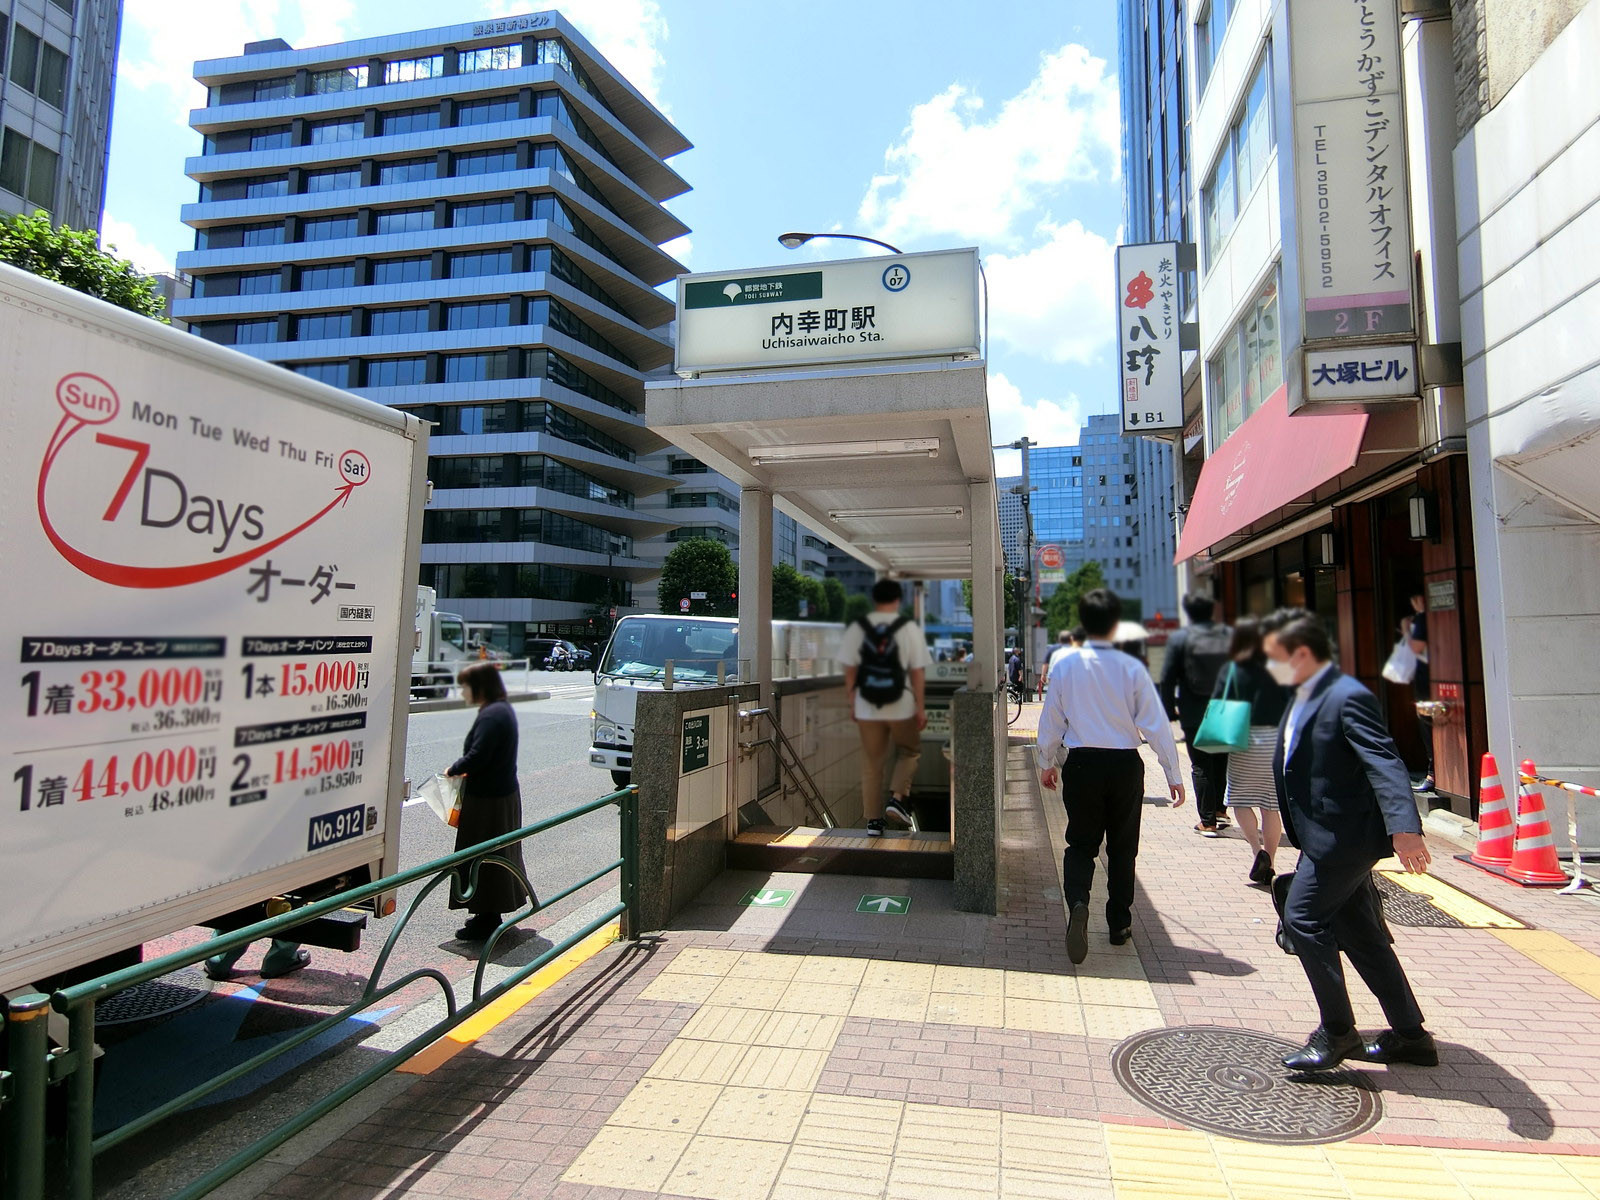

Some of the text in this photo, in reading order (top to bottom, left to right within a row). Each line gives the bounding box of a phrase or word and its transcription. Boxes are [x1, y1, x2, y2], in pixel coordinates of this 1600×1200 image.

[1354, 0, 1395, 281] とうかずこデンタルオフィス
[744, 282, 783, 293] 都営地下鉄
[889, 276, 903, 287] 07
[759, 291, 783, 299] SUBWAY
[1158, 257, 1174, 340] 炭火やきとり
[771, 305, 876, 337] 内幸町駅
[762, 330, 885, 350] Uchisaiwaicho Sta.
[1312, 360, 1408, 386] 大塚ビル
[66, 384, 366, 477] Sun Mon Tue Wed Thu Fri Sat
[1145, 412, 1164, 423] B1
[246, 560, 356, 604] オーダー
[340, 607, 373, 619] 国内縫製
[313, 810, 361, 845] No.912
